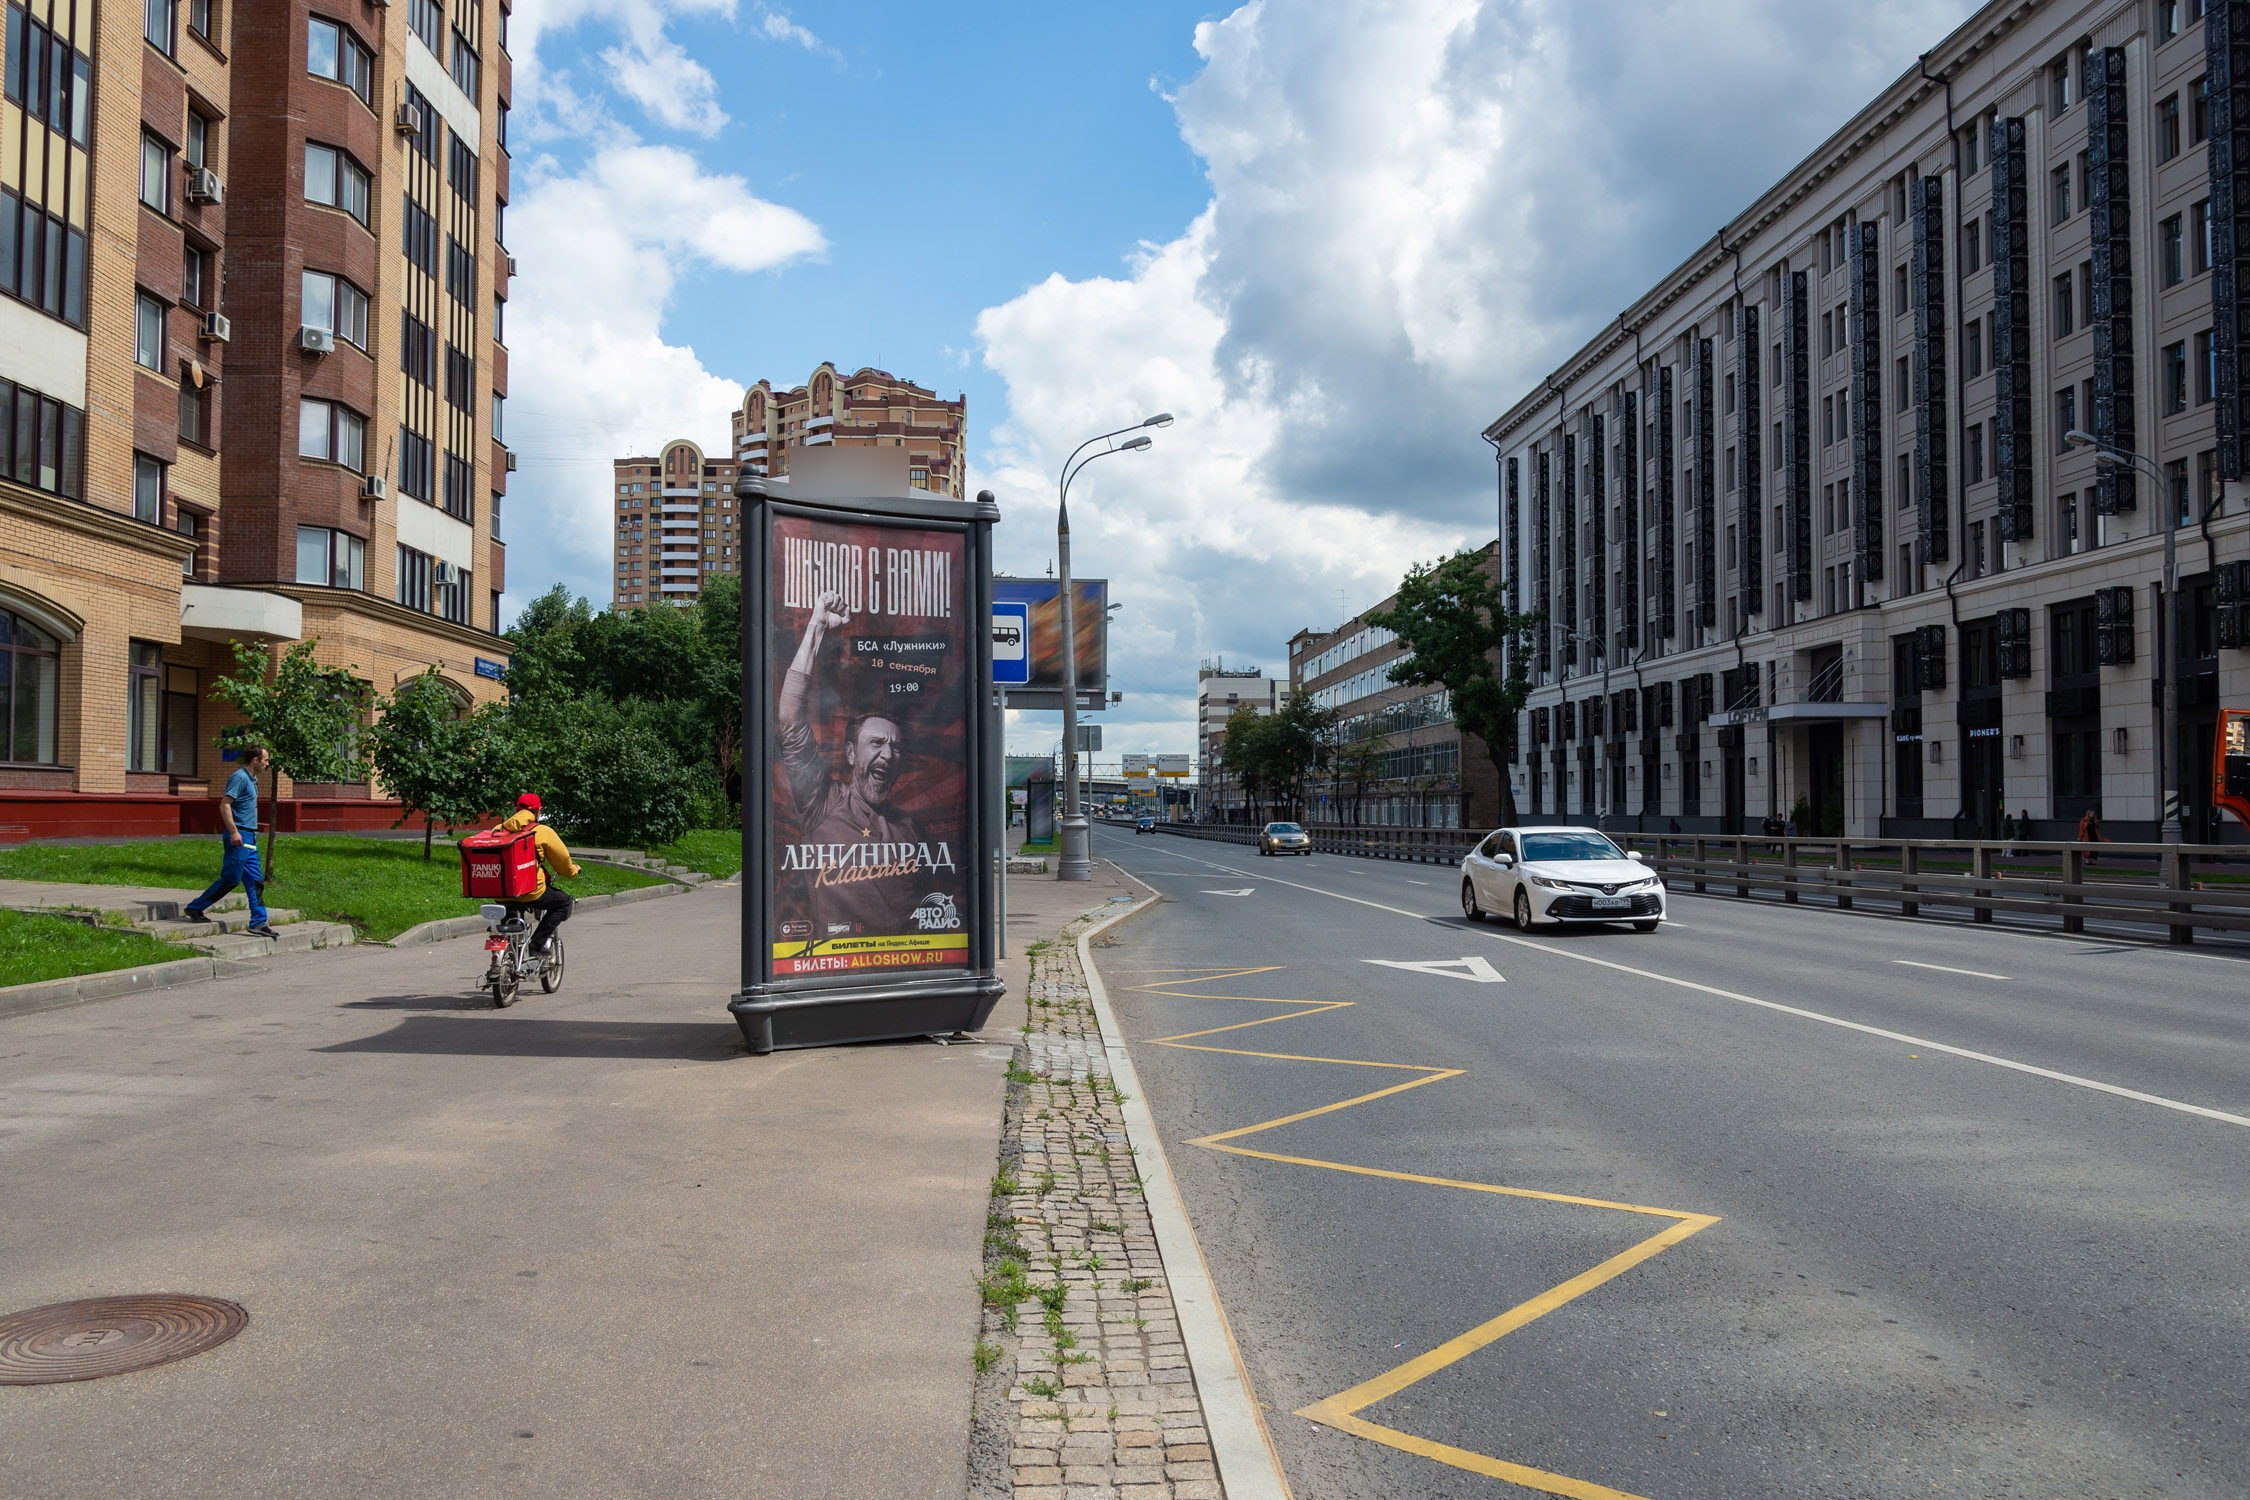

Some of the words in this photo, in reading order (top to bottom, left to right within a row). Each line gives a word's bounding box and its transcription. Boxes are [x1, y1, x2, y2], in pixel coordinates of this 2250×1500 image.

[784, 536, 863, 613] ШНУРОВ
[868, 546, 880, 614] С
[887, 547, 950, 618] ВАМИ!
[857, 640, 878, 651] БСА
[883, 640, 946, 652] «Лужники»
[871, 658, 883, 668] 10
[889, 661, 936, 675] сентября
[889, 683, 919, 693] 19:00
[781, 842, 956, 874] ЛЕНИНГРАД
[814, 859, 919, 888] Классика
[909, 907, 942, 919] АВТО
[919, 917, 960, 929] РАДИО
[832, 941, 876, 950] БИЛЕТЫ
[793, 957, 848, 972] БИЛЕТЫ:
[851, 952, 943, 967] ALLOSHOW.RU
